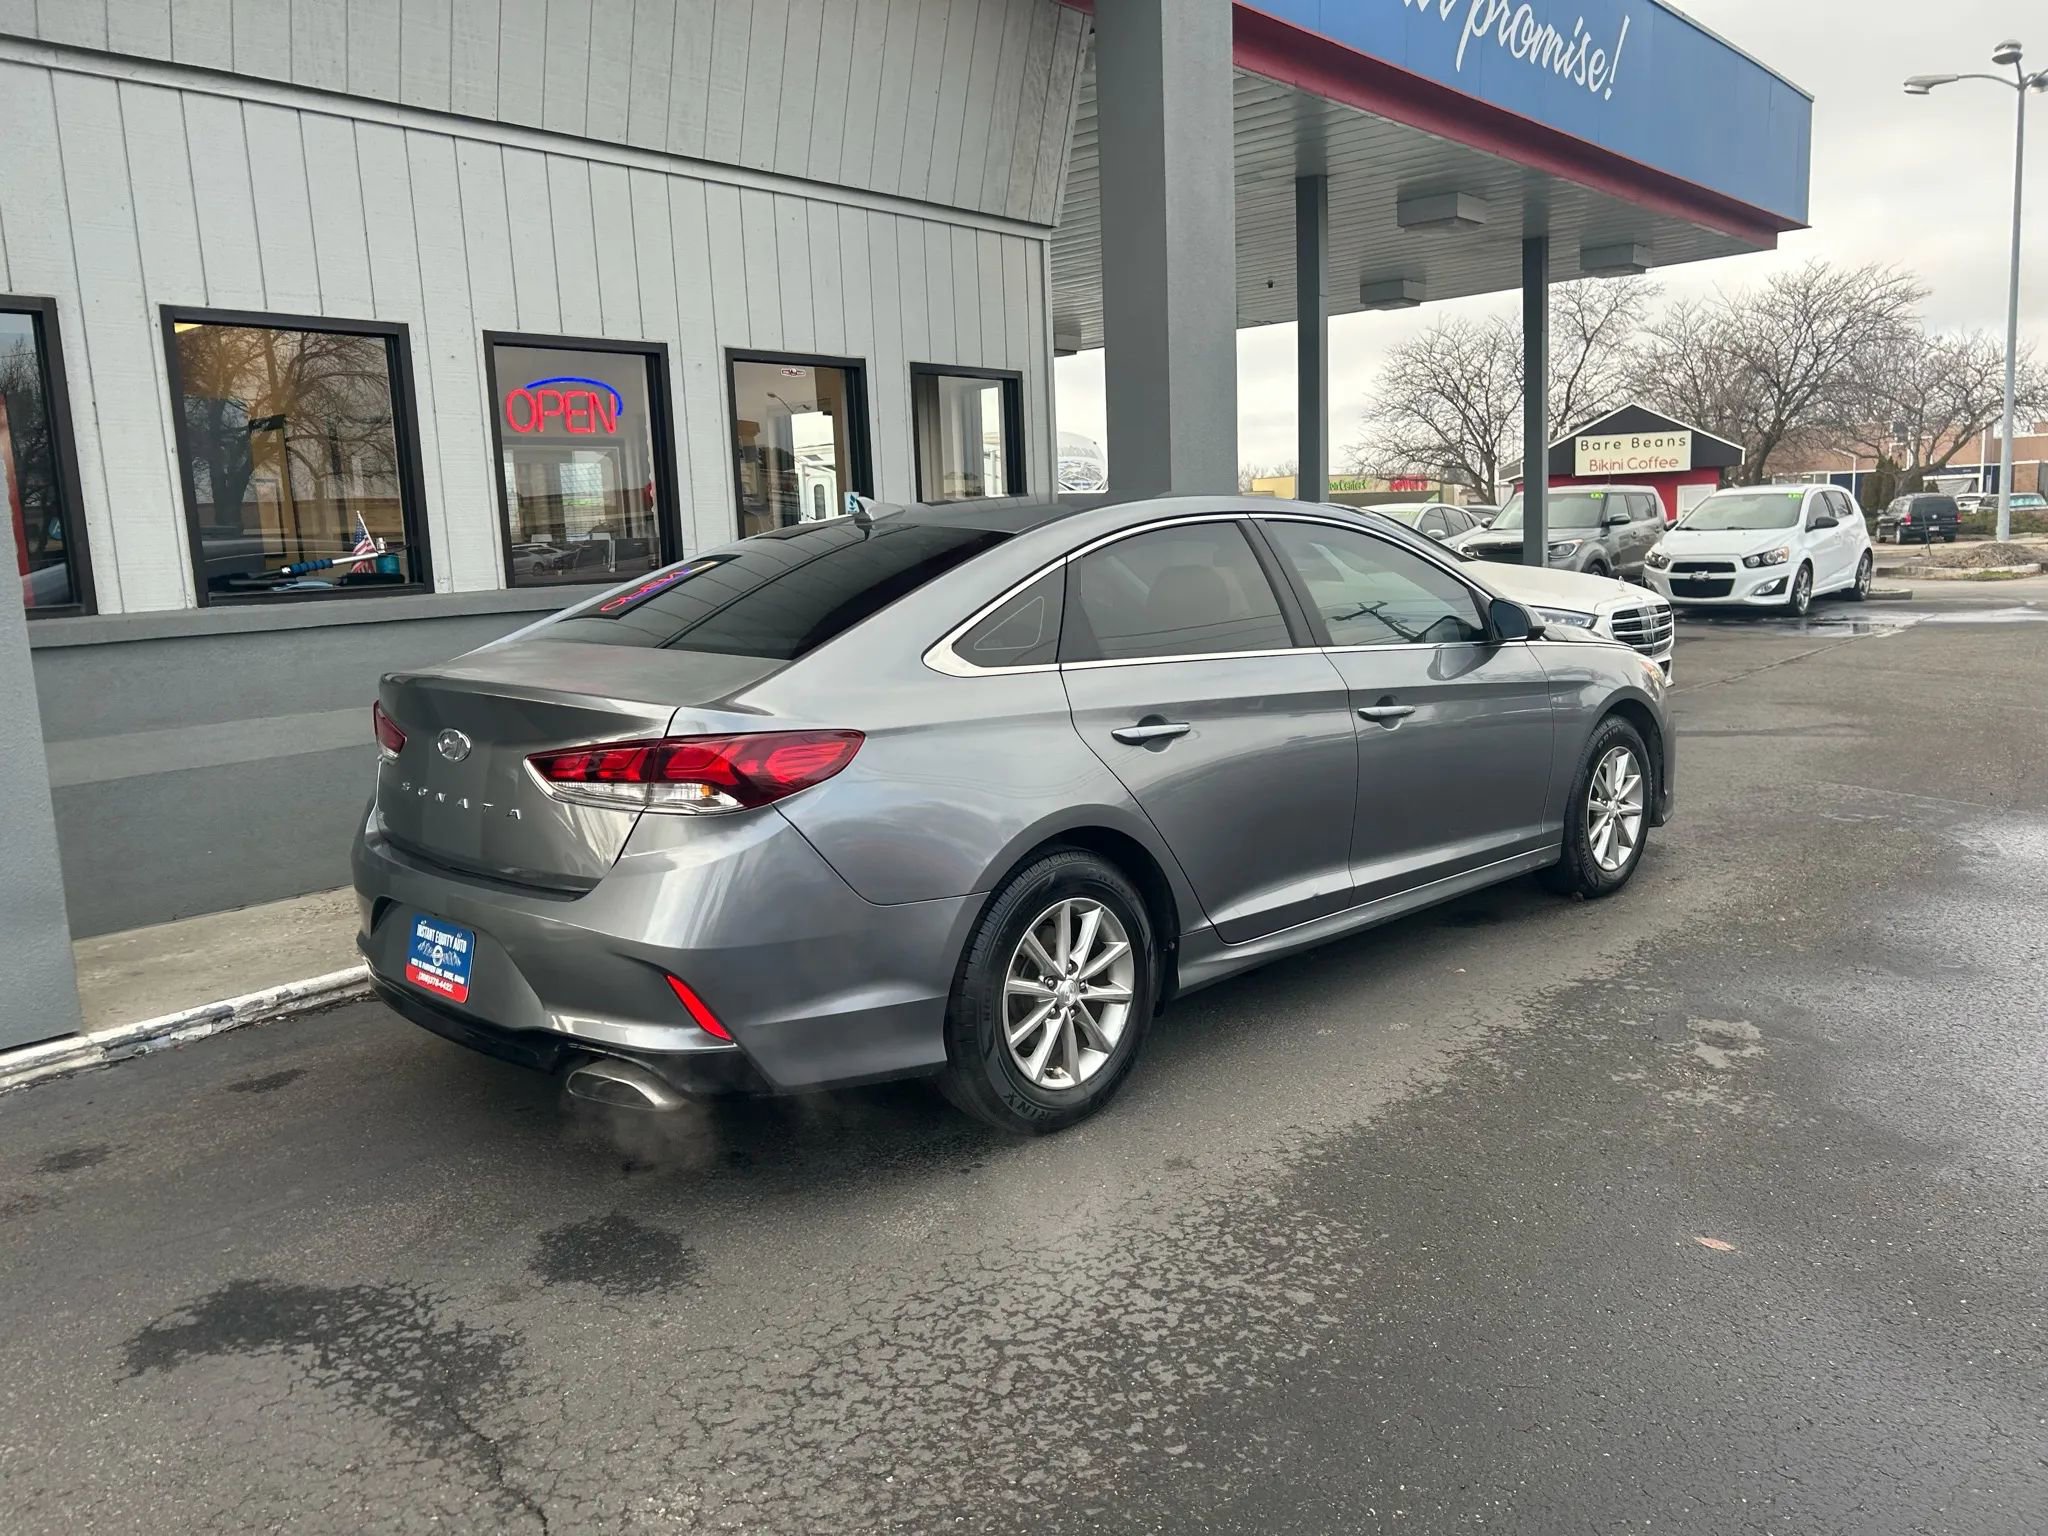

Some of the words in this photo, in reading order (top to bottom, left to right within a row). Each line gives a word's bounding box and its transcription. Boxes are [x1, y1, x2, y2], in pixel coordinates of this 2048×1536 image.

[1455, 0, 1630, 101] promise!
[505, 388, 617, 435] OPEN
[1581, 440, 1621, 452] Bare
[1631, 437, 1686, 449] Beans
[1589, 459, 1624, 472] Bikini
[1627, 456, 1679, 470] Coffee
[402, 781, 522, 821] SONATA
[453, 937, 467, 954] AUTO
